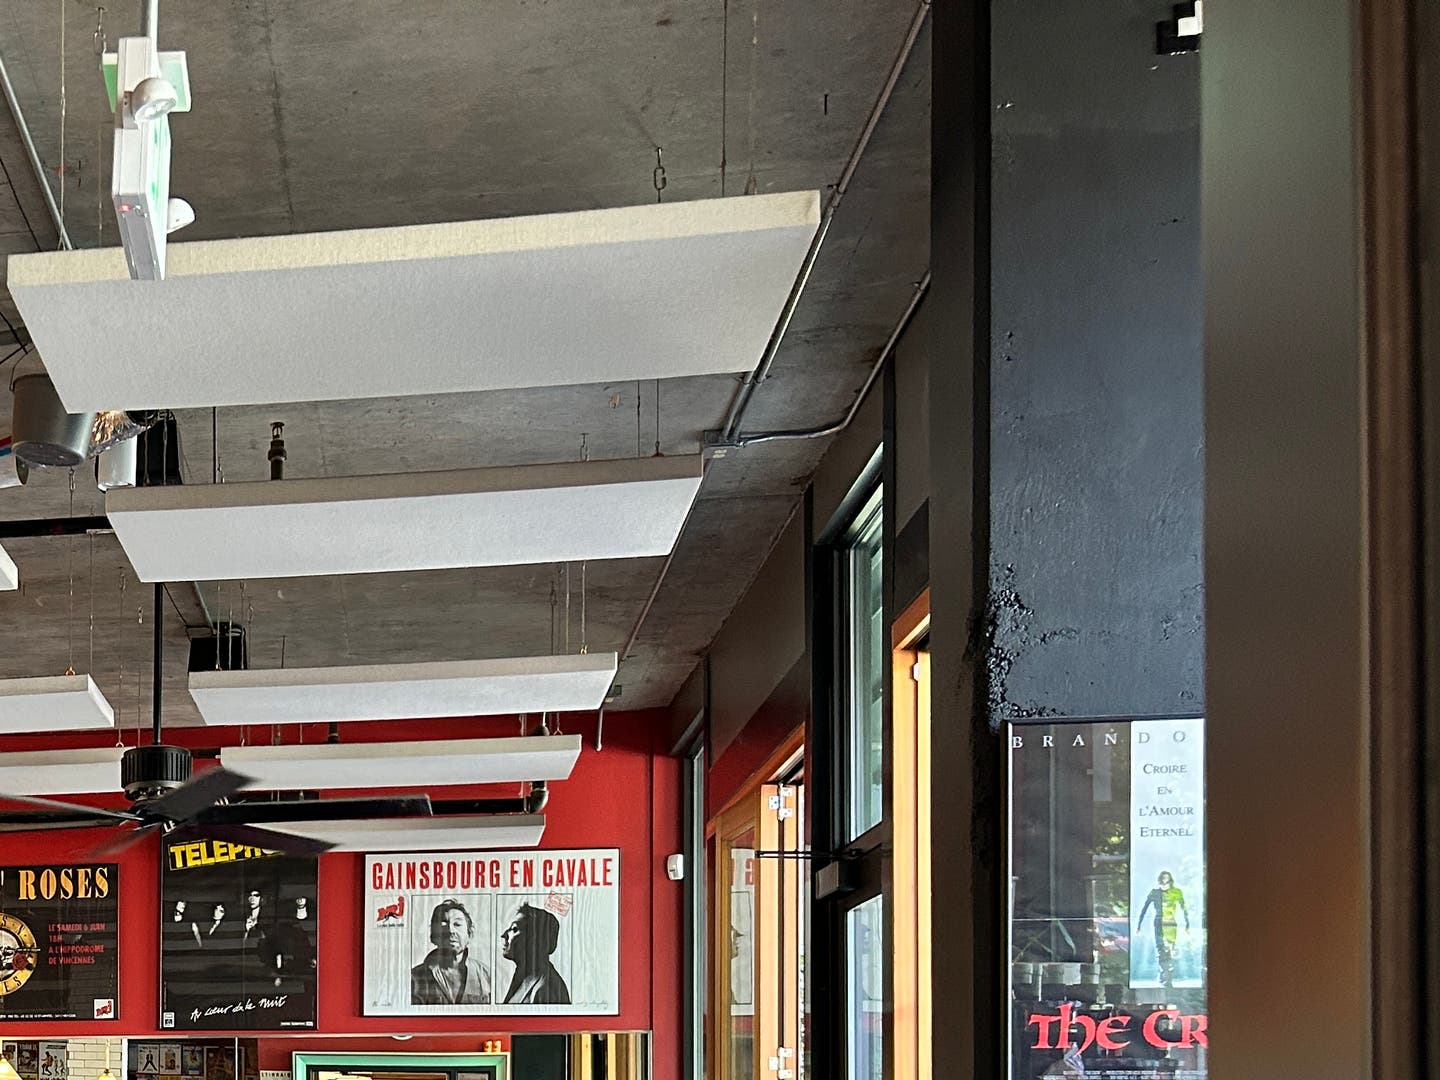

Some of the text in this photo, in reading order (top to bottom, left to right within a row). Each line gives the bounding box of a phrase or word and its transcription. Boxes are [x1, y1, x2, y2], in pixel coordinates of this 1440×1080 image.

[18, 867, 109, 900] ROSES
[372, 857, 613, 890] GAINSBOURG EN CAVALE
